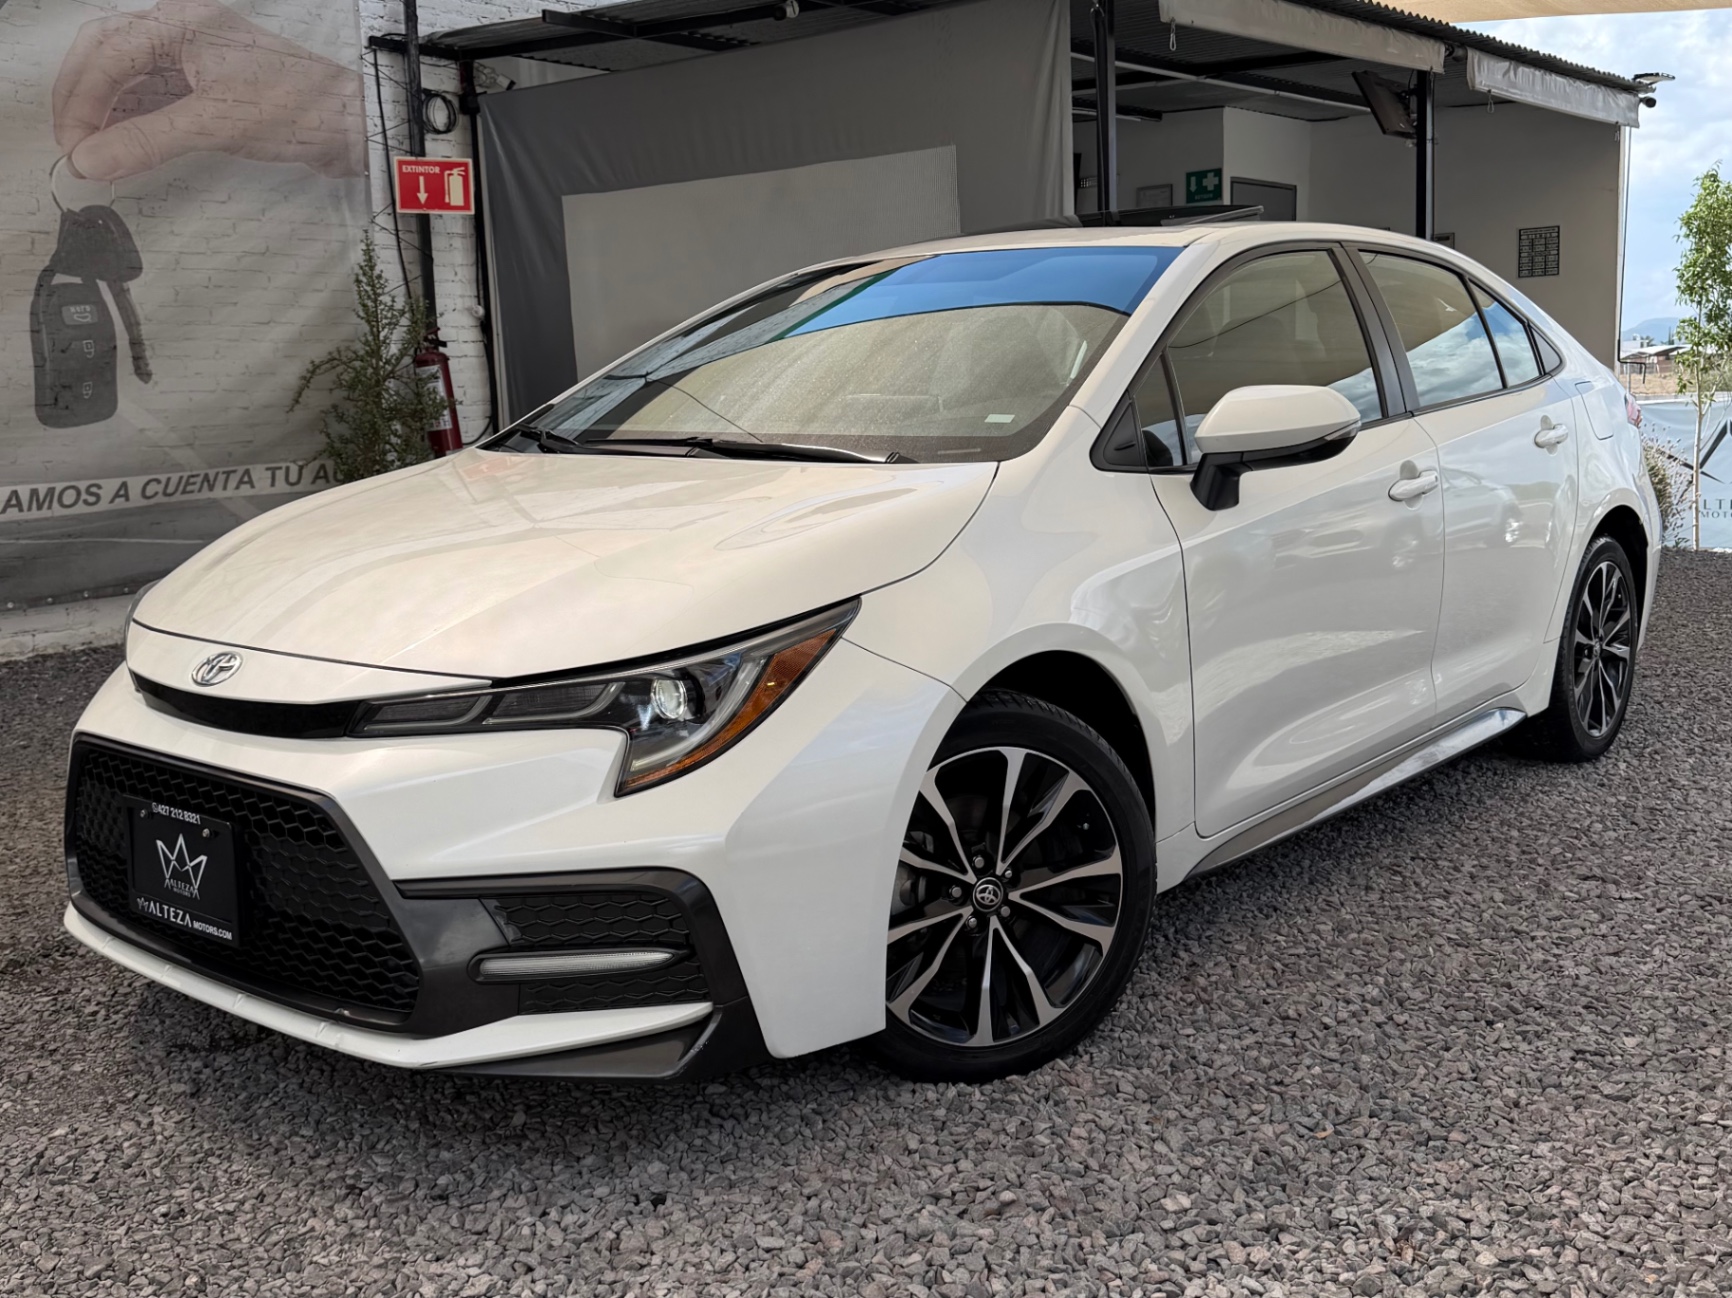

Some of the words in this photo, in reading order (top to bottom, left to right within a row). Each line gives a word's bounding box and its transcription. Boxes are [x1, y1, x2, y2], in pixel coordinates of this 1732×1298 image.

[402, 165, 440, 174] EXTINTOR
[0, 482, 102, 514] AMOS
[108, 481, 131, 504] A
[141, 468, 256, 499] CUENTA
[265, 464, 304, 488] TU
[1699, 510, 1732, 519] MOT
[158, 804, 170, 816] 427
[170, 807, 184, 820] 212
[183, 811, 201, 825] 8321
[170, 878, 194, 894] ALTEZA
[148, 900, 192, 928] ALTEZA
[193, 920, 233, 940] MOTORS.COM
